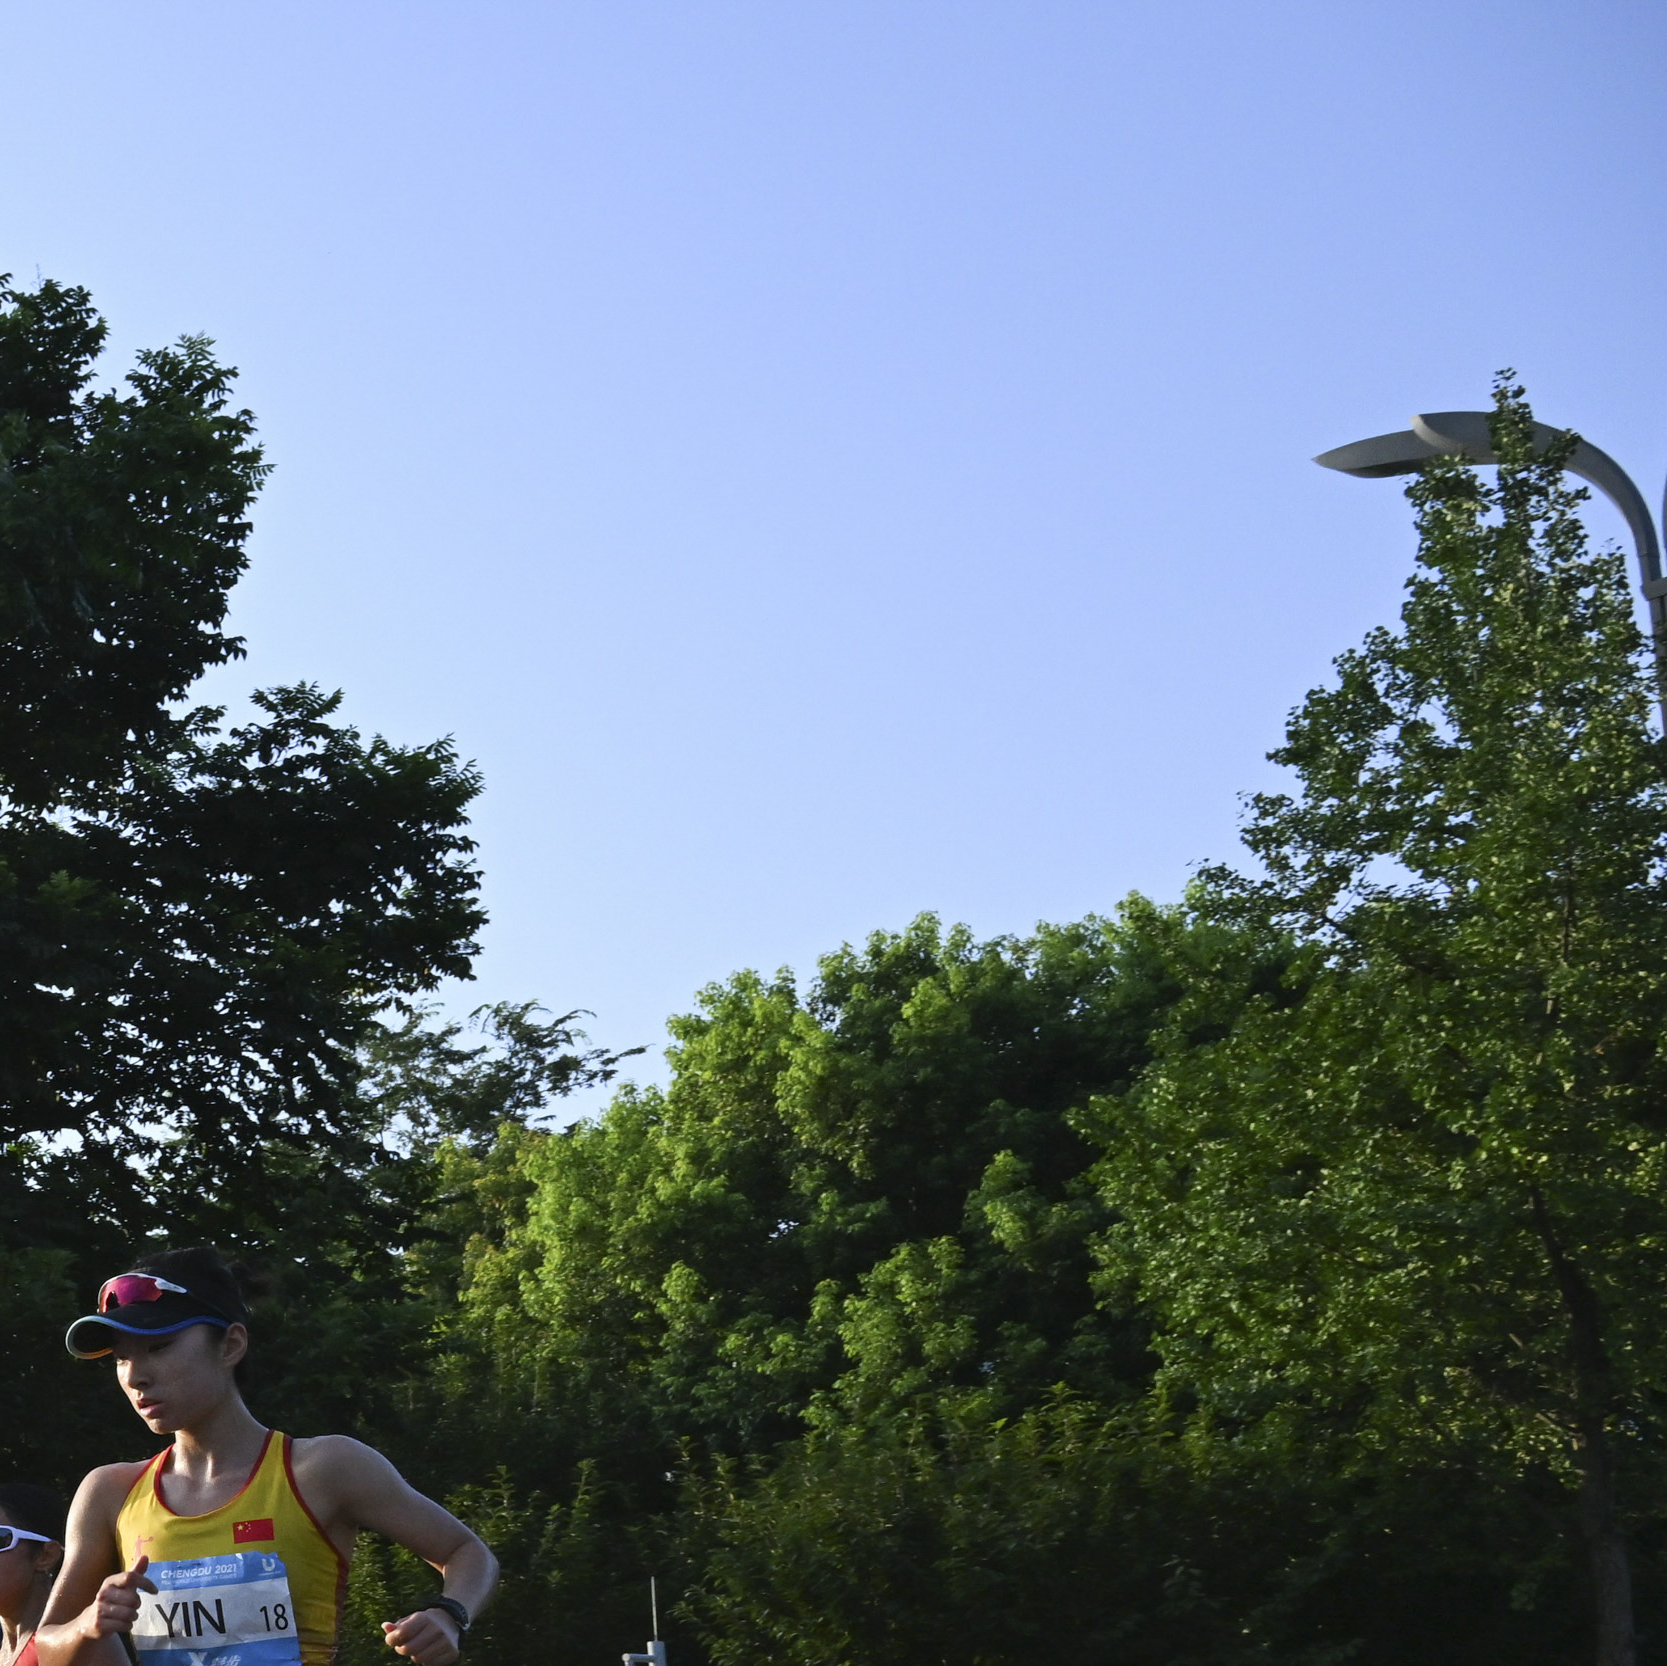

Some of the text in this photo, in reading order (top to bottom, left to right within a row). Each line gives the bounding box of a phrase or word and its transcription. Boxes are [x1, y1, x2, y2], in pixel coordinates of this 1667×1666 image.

[161, 1564, 237, 1580] CHENGDU 2021
[155, 1599, 289, 1637] YIN 18
